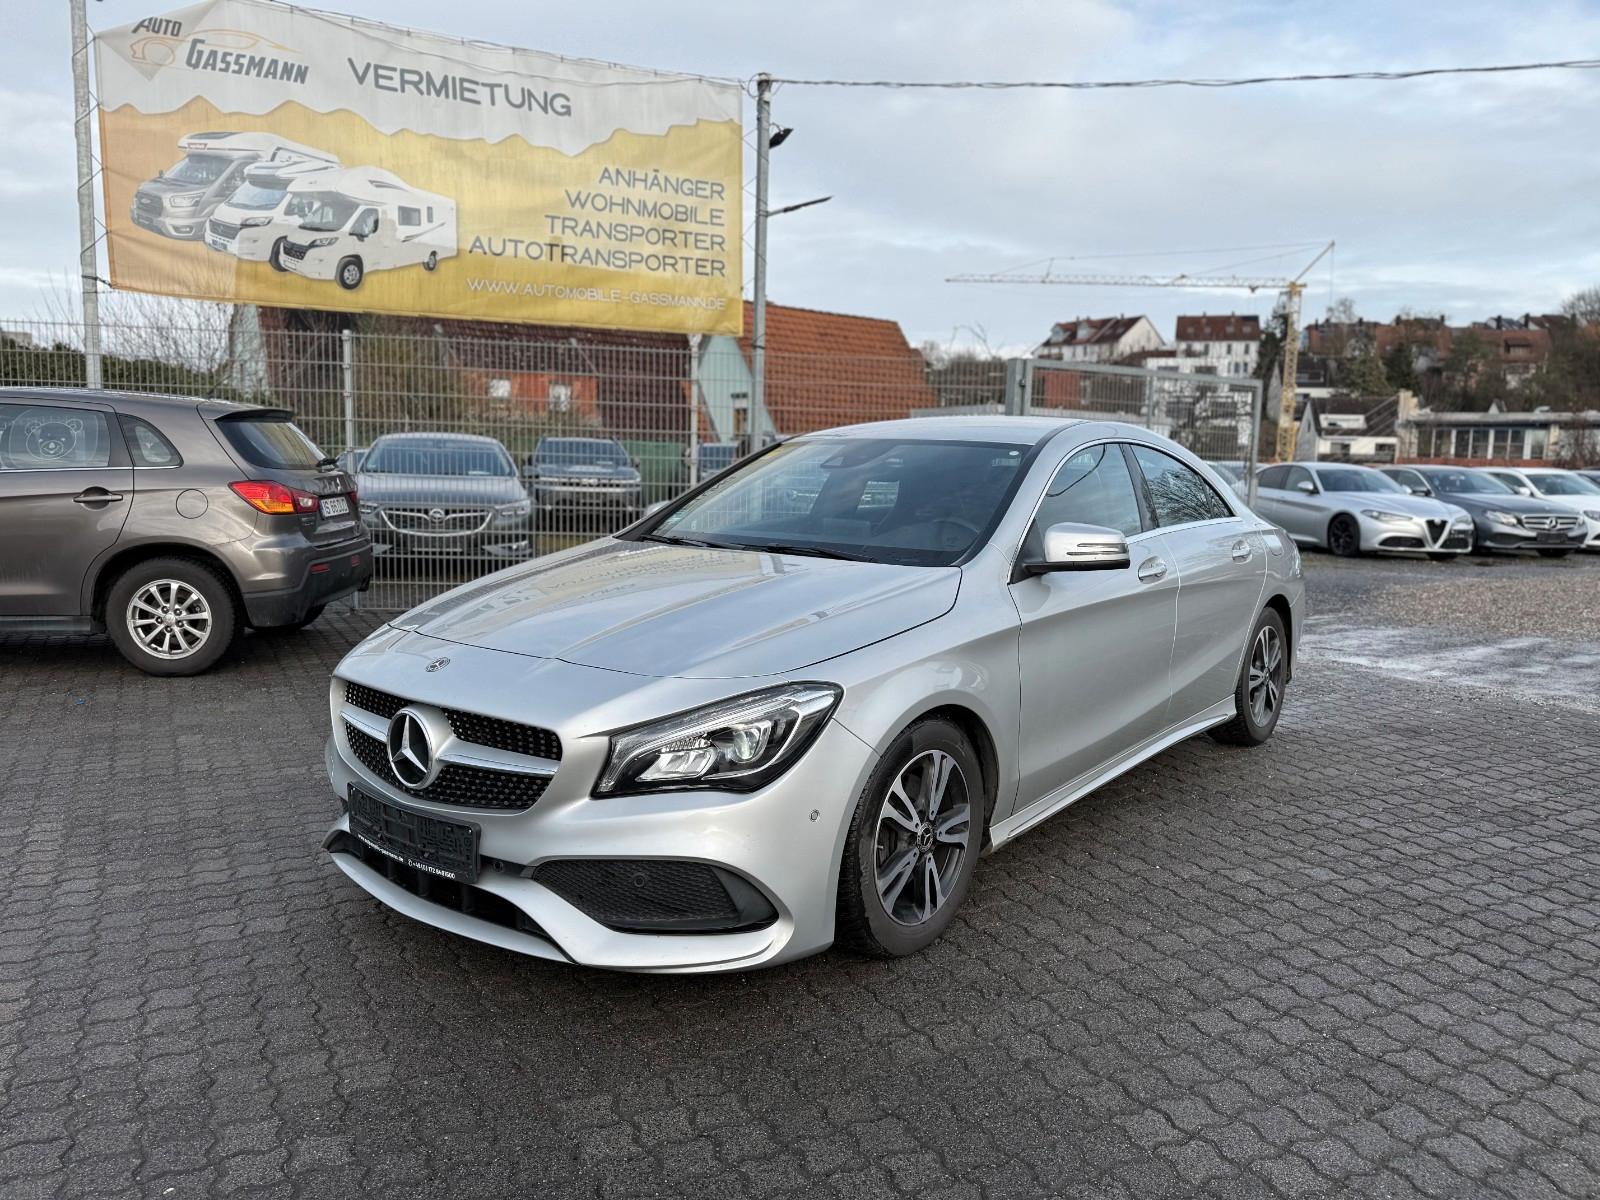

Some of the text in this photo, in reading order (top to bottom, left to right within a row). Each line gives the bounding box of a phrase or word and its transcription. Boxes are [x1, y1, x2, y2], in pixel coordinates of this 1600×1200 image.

[131, 17, 183, 37] AUTO
[186, 38, 309, 84] GASSMANN
[347, 57, 572, 117] VERMIETUNG
[599, 167, 725, 200] ANHÄNGER
[565, 189, 725, 227] WOHNMOBILE
[544, 215, 726, 251] TRANSPORTER
[469, 236, 726, 277] AUTOTRANSPORTER
